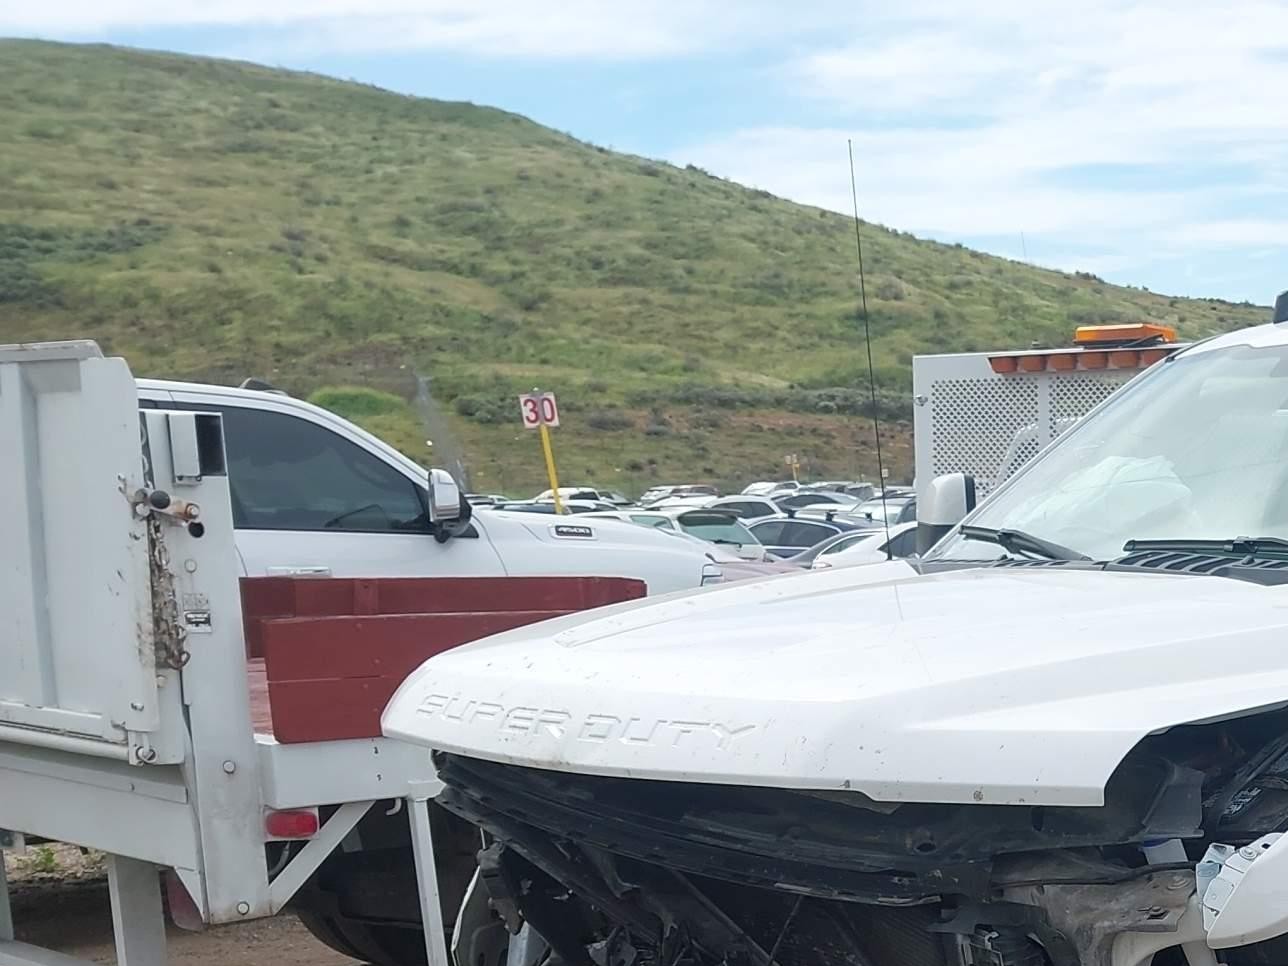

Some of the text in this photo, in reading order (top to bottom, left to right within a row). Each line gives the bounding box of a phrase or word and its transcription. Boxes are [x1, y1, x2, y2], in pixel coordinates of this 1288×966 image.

[523, 397, 555, 423] 30
[416, 694, 757, 751] SUPER DUTY
